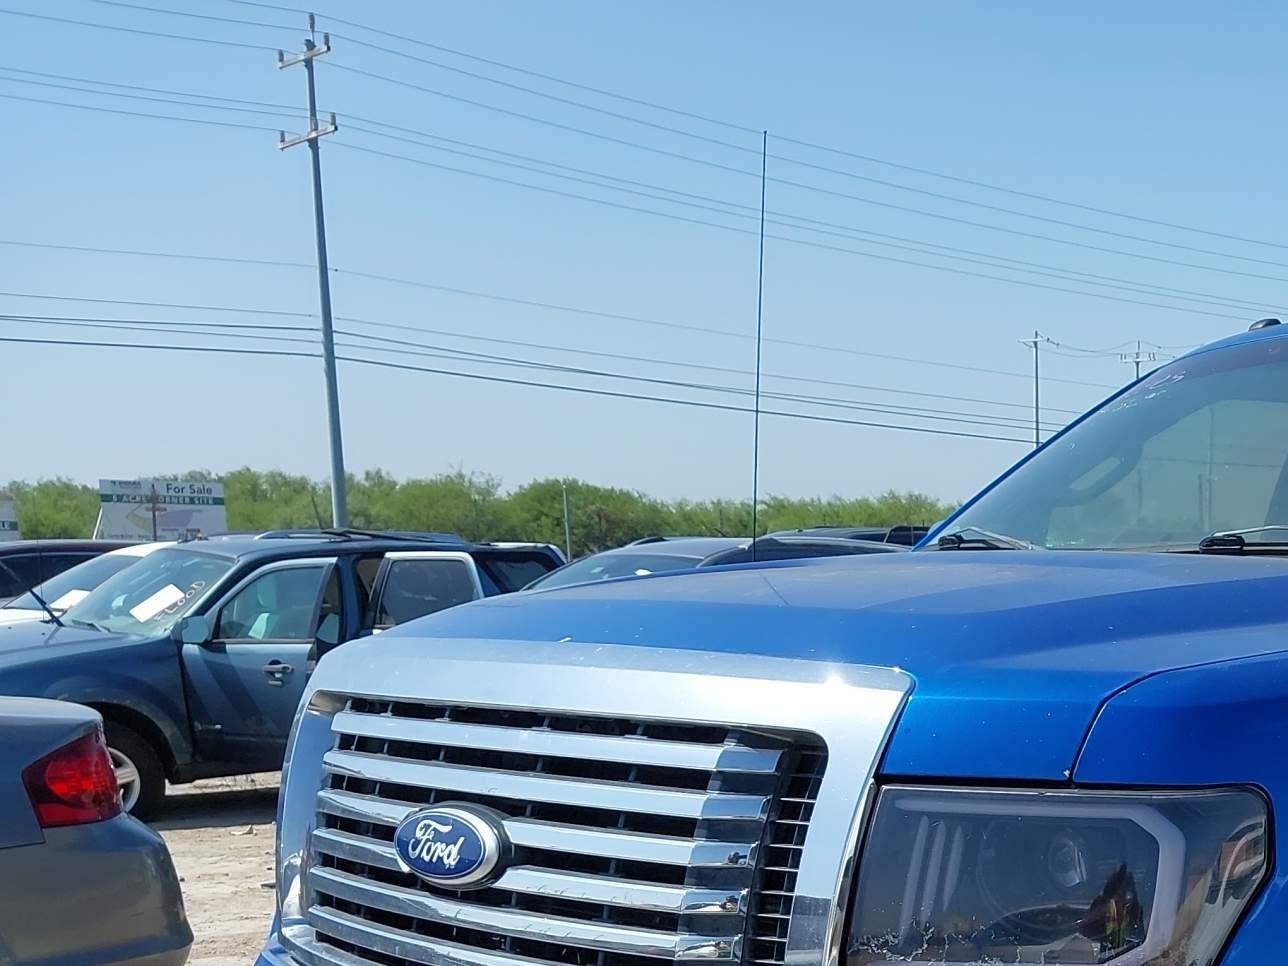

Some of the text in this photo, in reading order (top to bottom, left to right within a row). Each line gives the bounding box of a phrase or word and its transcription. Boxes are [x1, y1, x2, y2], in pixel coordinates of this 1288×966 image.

[166, 483, 213, 495] For Sale
[408, 819, 465, 867] Ford
